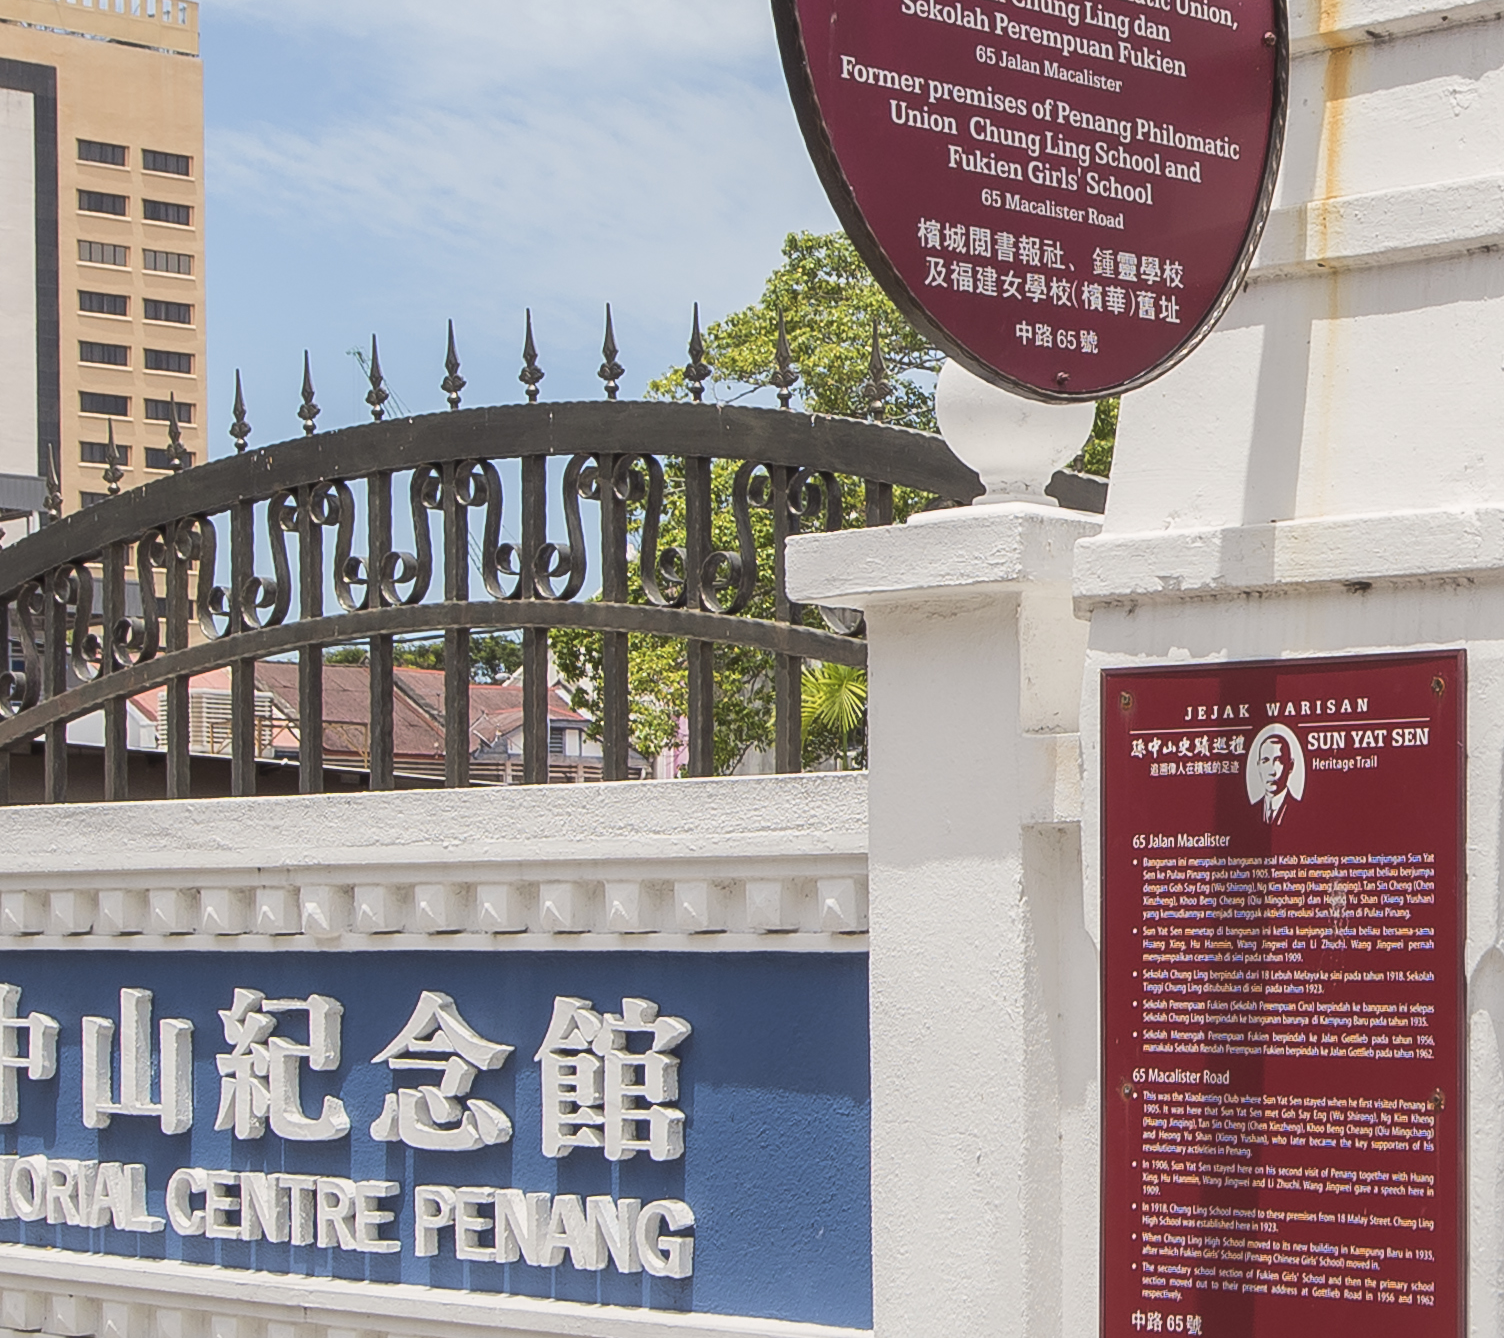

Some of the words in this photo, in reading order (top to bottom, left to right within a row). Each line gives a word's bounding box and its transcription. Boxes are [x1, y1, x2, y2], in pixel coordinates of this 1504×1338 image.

[1084, 1, 1130, 38] Ling
[1133, 14, 1171, 42] dan
[994, 11, 1114, 60] Perempuan
[1118, 34, 1187, 77] Fukien
[975, 44, 996, 65] 65
[998, 50, 1040, 75] Jalan
[1043, 59, 1123, 92] Macalister
[840, 54, 925, 94] Former
[927, 79, 1027, 116] premises
[1031, 98, 1054, 121] of
[1056, 100, 1132, 143] Penang
[1135, 117, 1239, 160] Philomatic
[889, 99, 958, 135] Union
[969, 116, 1041, 157] Chung
[1044, 130, 1091, 167] Ling
[1095, 141, 1161, 175] School
[1164, 161, 1201, 183] and
[948, 144, 1023, 181] Fukien
[1027, 160, 1081, 191] Girls'
[1086, 171, 1153, 205] School
[981, 188, 1001, 207] 65
[1004, 192, 1085, 222] Macalister
[1087, 207, 1124, 229] Road
[1184, 704, 1249, 720] JEJAK
[1265, 697, 1368, 716] WARISAN
[1307, 731, 1346, 752] SUN
[1350, 729, 1387, 748] YAT
[1391, 727, 1429, 747] SEN
[1312, 757, 1354, 772] Heritage
[1355, 754, 1377, 768] Trail
[1132, 834, 1146, 848] 65
[1147, 833, 1174, 848] Jalan
[1177, 832, 1230, 847] Macalister
[1142, 968, 1169, 979] Sekolah
[1169, 969, 1192, 981] Chung
[1193, 969, 1208, 981] Ling
[1261, 970, 1269, 980] 18
[1270, 969, 1292, 980] Lebuh
[1343, 970, 1361, 982] pada
[1362, 970, 1384, 981] tahun
[1132, 1067, 1146, 1082] 65
[1148, 1067, 1201, 1084] Macalister
[1203, 1069, 1229, 1084] Road
[164, 1166, 402, 1253] CENTRE
[414, 1184, 696, 1279] PENANG
[1141, 1201, 1149, 1212] In
[1192, 1204, 1207, 1217] Ling
[1208, 1205, 1231, 1216] School
[1232, 1208, 1256, 1218] moved
[1257, 1209, 1265, 1218] to
[1266, 1209, 1285, 1220] these
[1286, 1211, 1317, 1222] premises
[1318, 1211, 1335, 1222] from
[1141, 1214, 1158, 1227] High
[1158, 1215, 1181, 1227] School
[1181, 1219, 1195, 1227] was
[1196, 1218, 1234, 1229] established
[1235, 1219, 1250, 1231] here
[1251, 1220, 1258, 1231] in
[1163, 1232, 1186, 1246] Chung
[1187, 1234, 1202, 1247] Ling
[1204, 1236, 1220, 1248] High
[1222, 1236, 1245, 1247] School
[1247, 1239, 1271, 1250] moved
[1272, 1240, 1280, 1250] to
[1282, 1240, 1291, 1251] its
[1292, 1242, 1308, 1252] new
[1309, 1242, 1339, 1256] building
[1340, 1244, 1348, 1254] in
[1386, 1246, 1403, 1258] Baru
[1405, 1248, 1413, 1259] in
[1220, 1249, 1243, 1260] School
[1272, 1252, 1300, 1265] Chinese
[1345, 1259, 1370, 1269] moved
